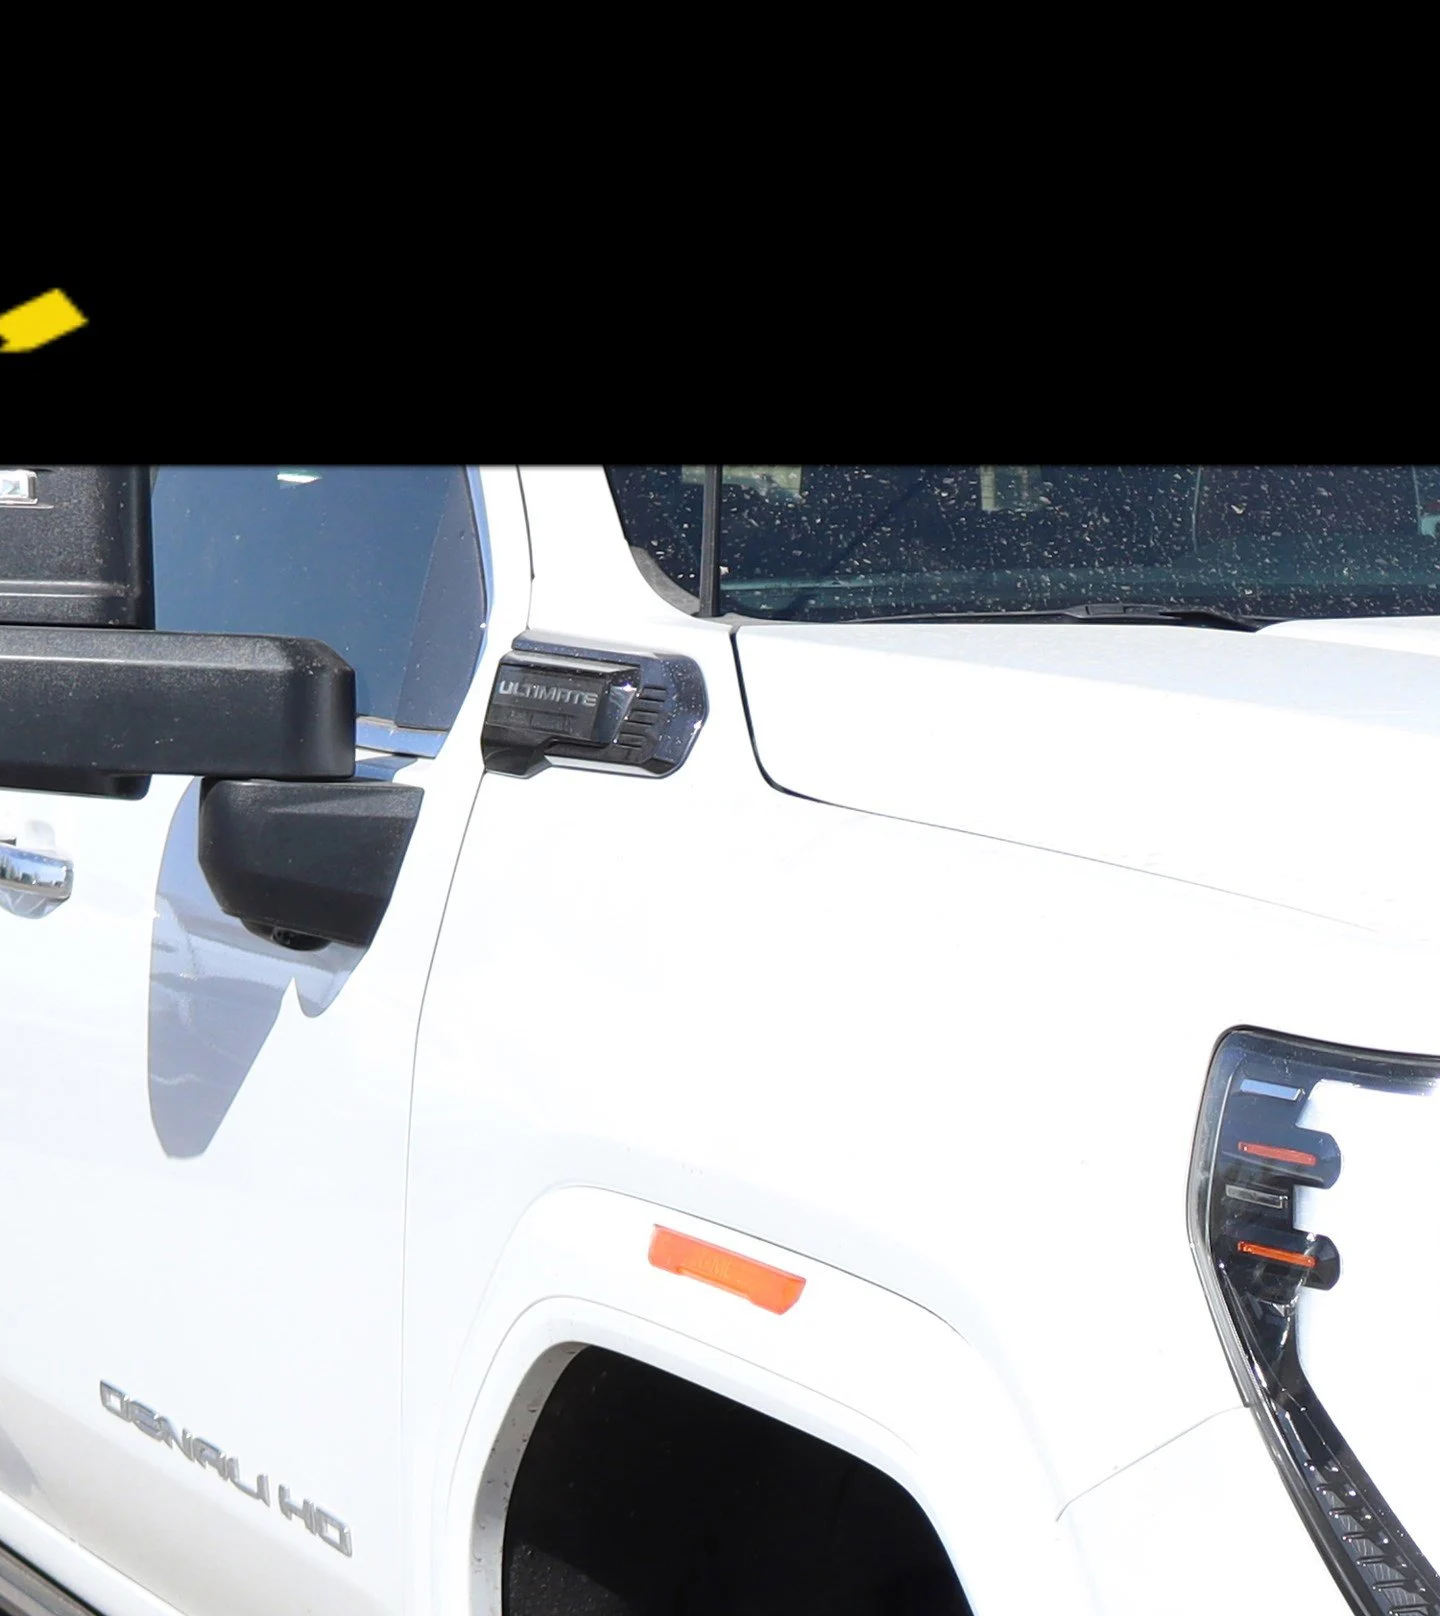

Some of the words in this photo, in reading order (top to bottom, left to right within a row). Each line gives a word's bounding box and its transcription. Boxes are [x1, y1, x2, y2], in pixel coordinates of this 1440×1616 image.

[498, 680, 598, 707] ULTIMATE
[100, 1379, 270, 1508] DENALI
[278, 1484, 352, 1557] HD
